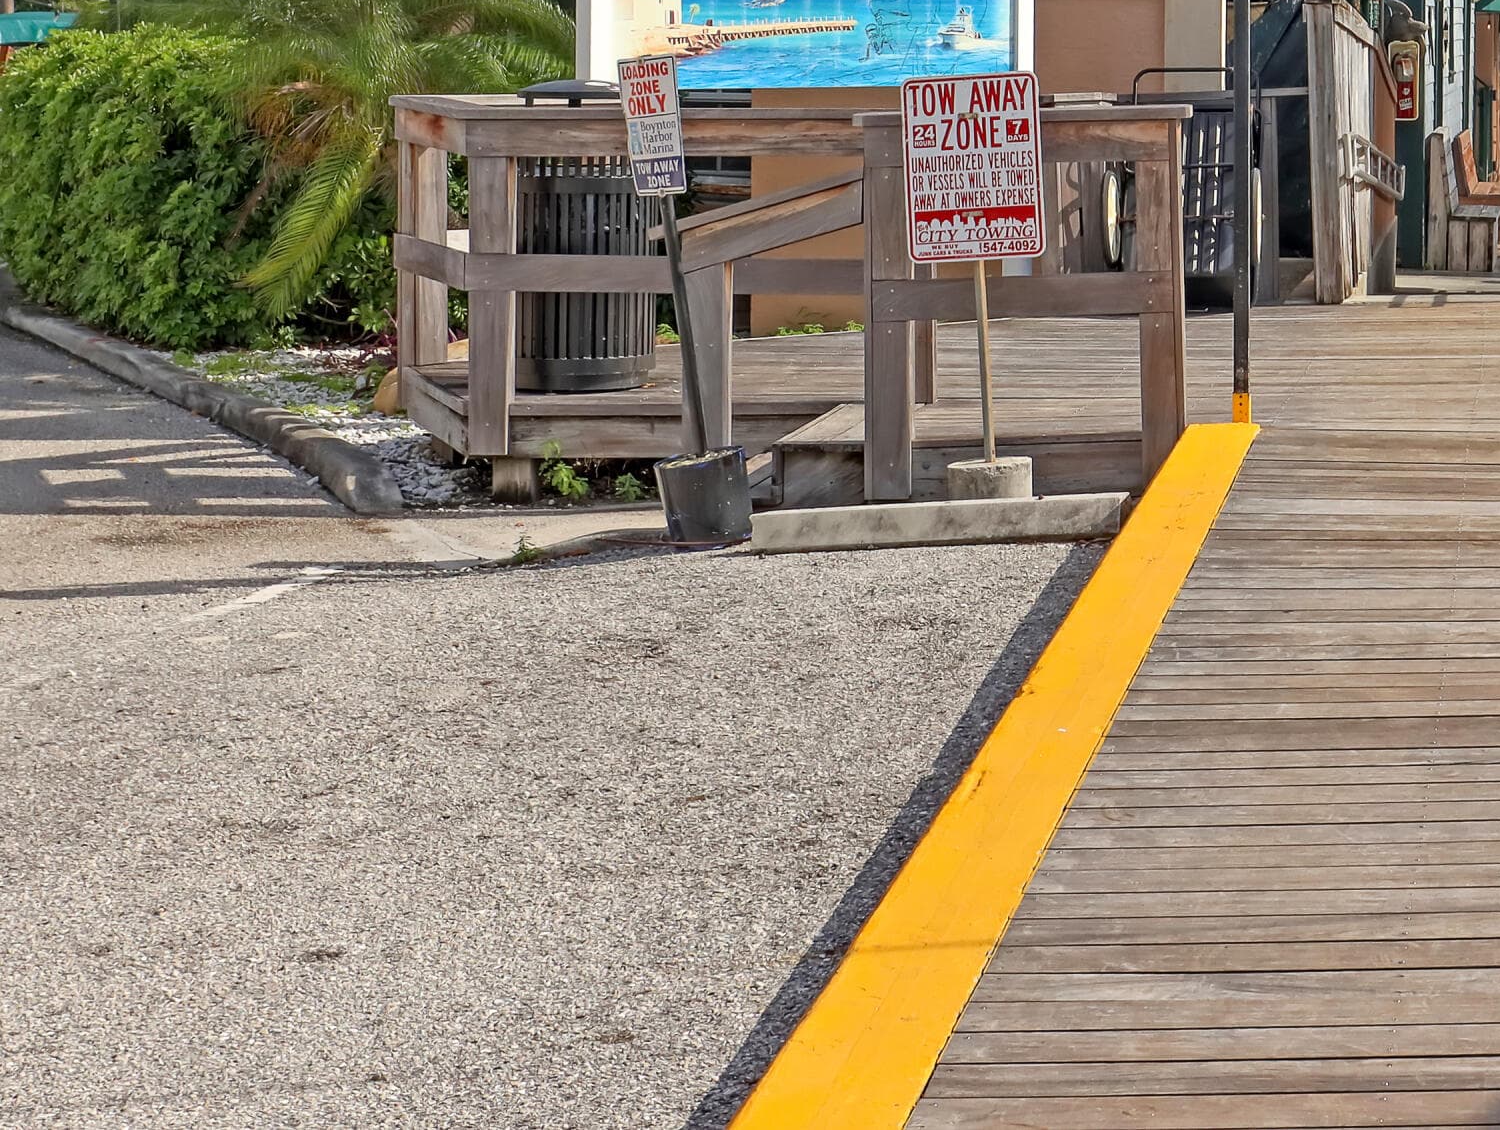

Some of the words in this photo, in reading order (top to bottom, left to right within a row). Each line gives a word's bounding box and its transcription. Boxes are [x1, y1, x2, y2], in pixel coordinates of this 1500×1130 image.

[622, 62, 668, 80] LOADING
[630, 79, 659, 96] ZONE
[628, 94, 666, 116] ONLY
[909, 83, 956, 117] TOW
[969, 78, 1028, 113] AWAY
[640, 120, 676, 132] Boynton
[914, 126, 935, 141] 24
[941, 116, 1002, 151] ZONE
[1012, 120, 1022, 134] 7
[642, 131, 673, 143] Harbor
[914, 140, 935, 148] HOURS
[1008, 134, 1028, 142] DAYS
[643, 143, 674, 155] Marina
[635, 162, 652, 175] TOW
[653, 159, 679, 174] AWAY
[911, 153, 984, 174] UNAUTHORIZED
[988, 150, 1033, 169] VEHICLES
[647, 174, 671, 188] ZONE
[912, 175, 924, 192] OR
[927, 173, 964, 191] VESSELS
[968, 171, 988, 189] WILL
[991, 170, 1003, 188] BE
[1006, 169, 1034, 187] TOWED
[914, 193, 936, 211] AWAY
[940, 191, 950, 209] AT
[955, 190, 991, 208] OWNERS
[996, 188, 1035, 207] EXPENSE
[918, 229, 958, 243] CITY
[967, 225, 1035, 240] TOWING
[983, 240, 1037, 253] 547-4092
